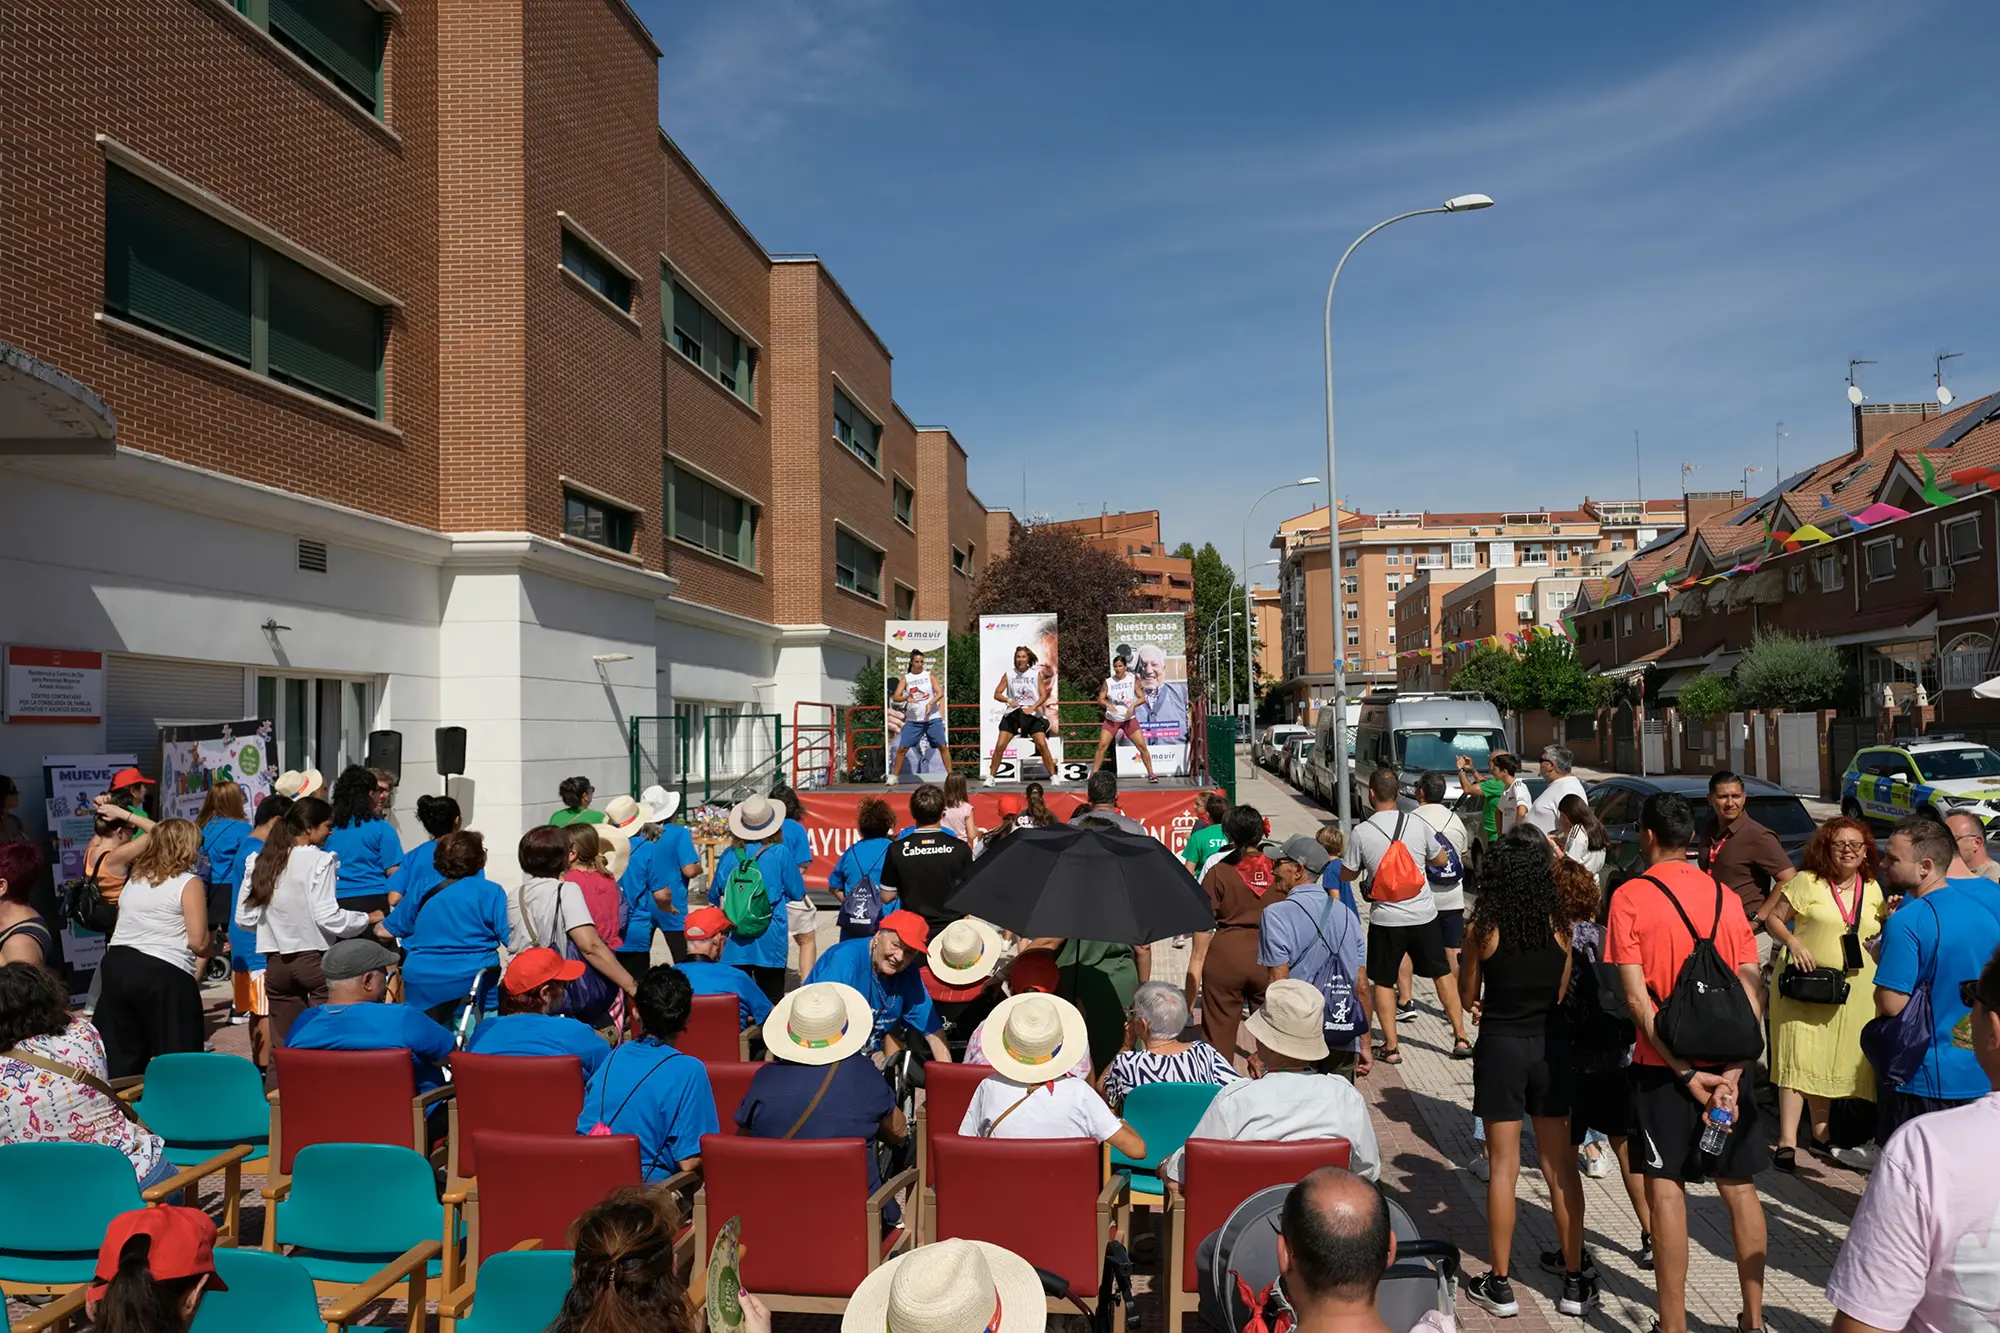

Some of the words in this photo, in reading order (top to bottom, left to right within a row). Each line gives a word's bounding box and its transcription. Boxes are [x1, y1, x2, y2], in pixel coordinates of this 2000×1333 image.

[1115, 622, 1154, 631] Nuestra
[1156, 622, 1177, 630] casa
[907, 630, 941, 638] amavir
[1133, 632, 1142, 641] tu
[1145, 631, 1174, 643] hogar
[995, 762, 1015, 779] 2
[1063, 763, 1088, 781] 3
[902, 844, 954, 857] Cabezuelo
